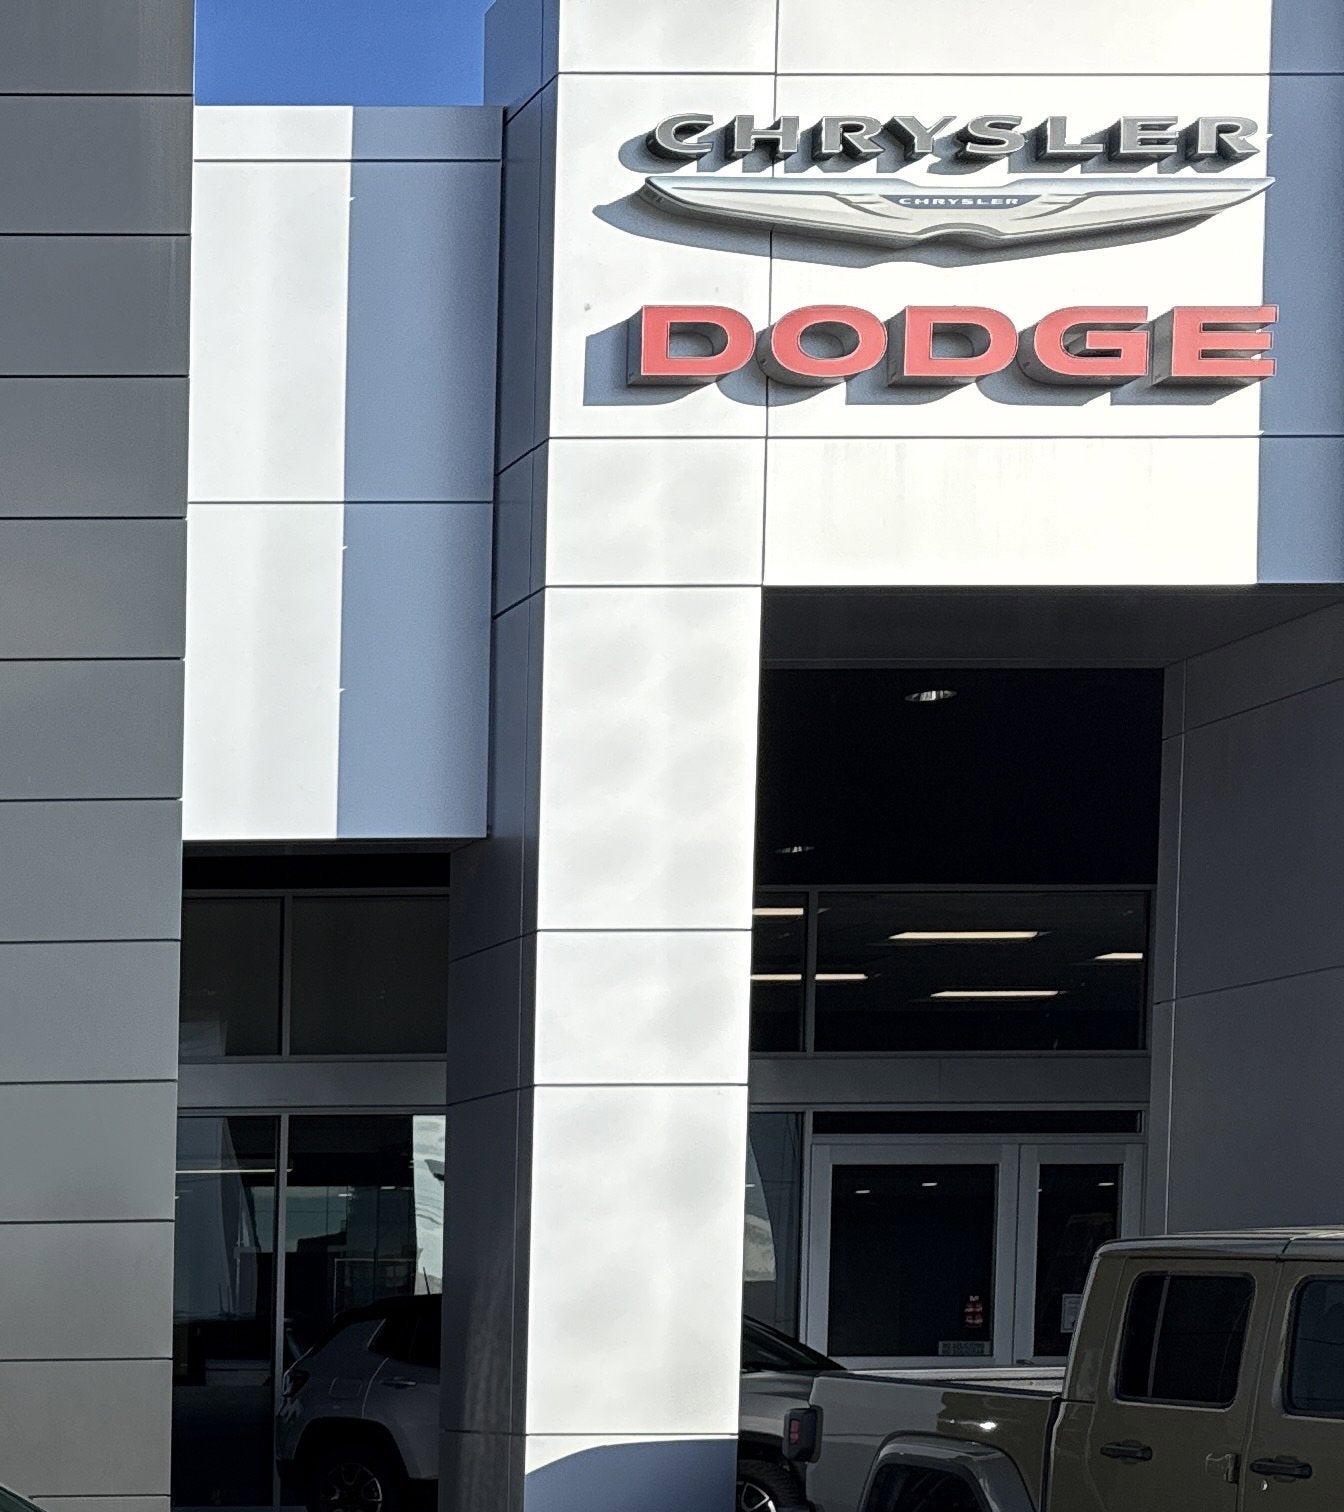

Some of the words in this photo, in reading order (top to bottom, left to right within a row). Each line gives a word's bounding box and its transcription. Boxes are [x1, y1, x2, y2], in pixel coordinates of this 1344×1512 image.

[647, 113, 1260, 160] CHRYSLER
[898, 197, 1020, 206] CHRYSLER
[640, 303, 1280, 378] DODGE
